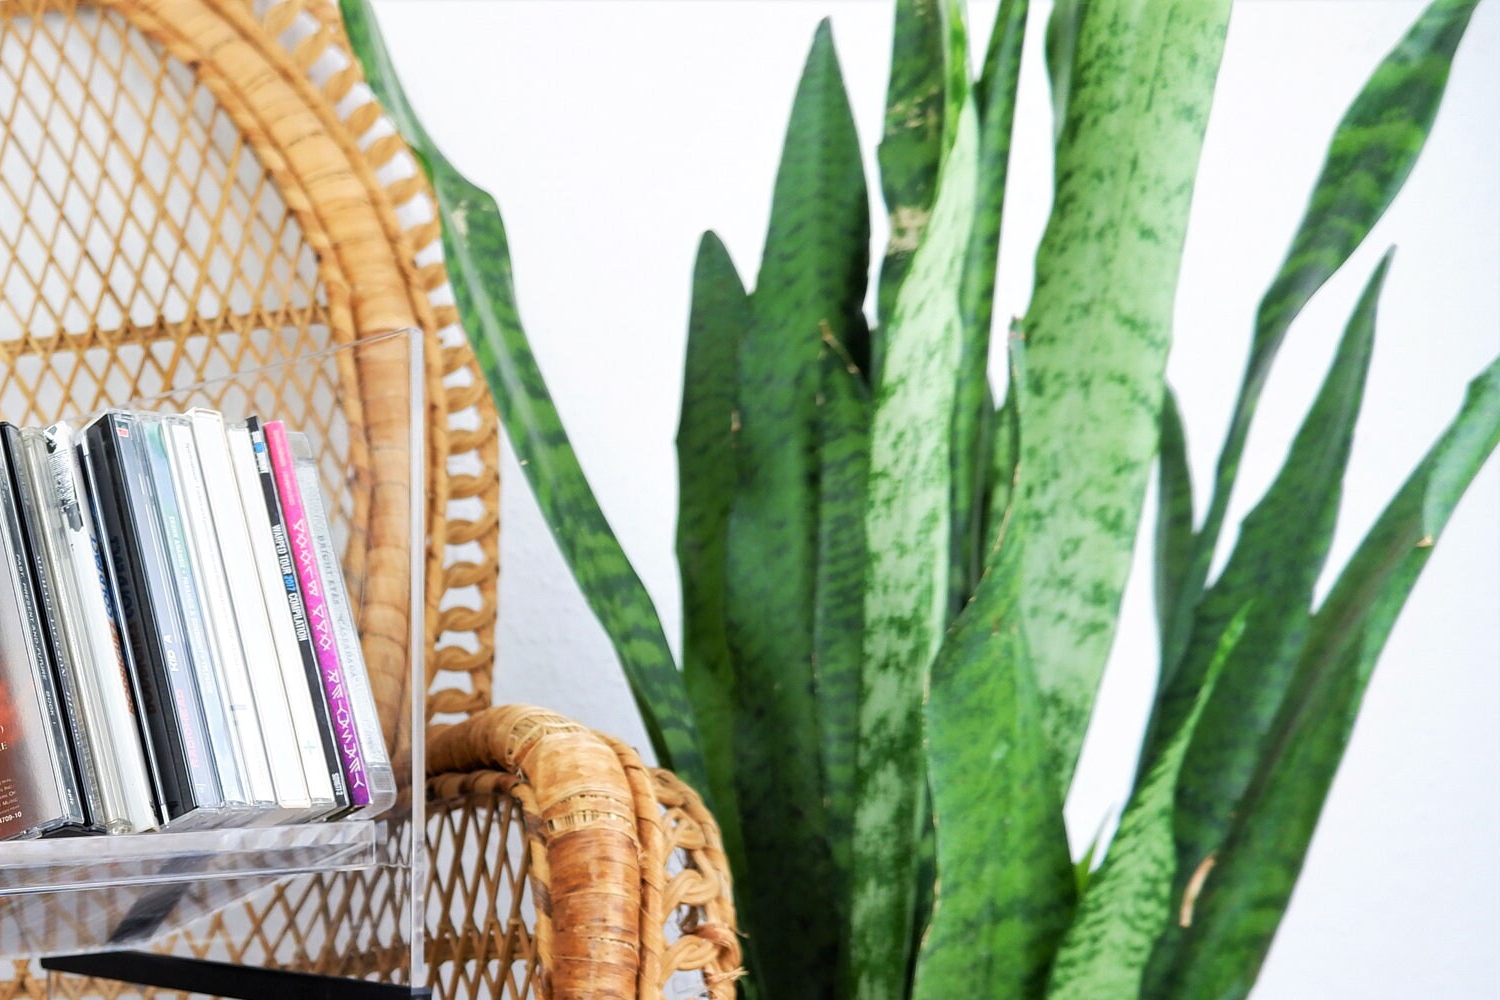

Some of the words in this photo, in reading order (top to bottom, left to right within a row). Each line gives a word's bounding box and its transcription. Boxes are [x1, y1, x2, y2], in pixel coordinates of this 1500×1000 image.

[272, 525, 286, 554] WARPED
[278, 555, 291, 573] TOUR
[283, 574, 296, 591] 2017
[288, 593, 306, 640] COMPILATION
[163, 634, 172, 643] A
[166, 649, 178, 671] KID
